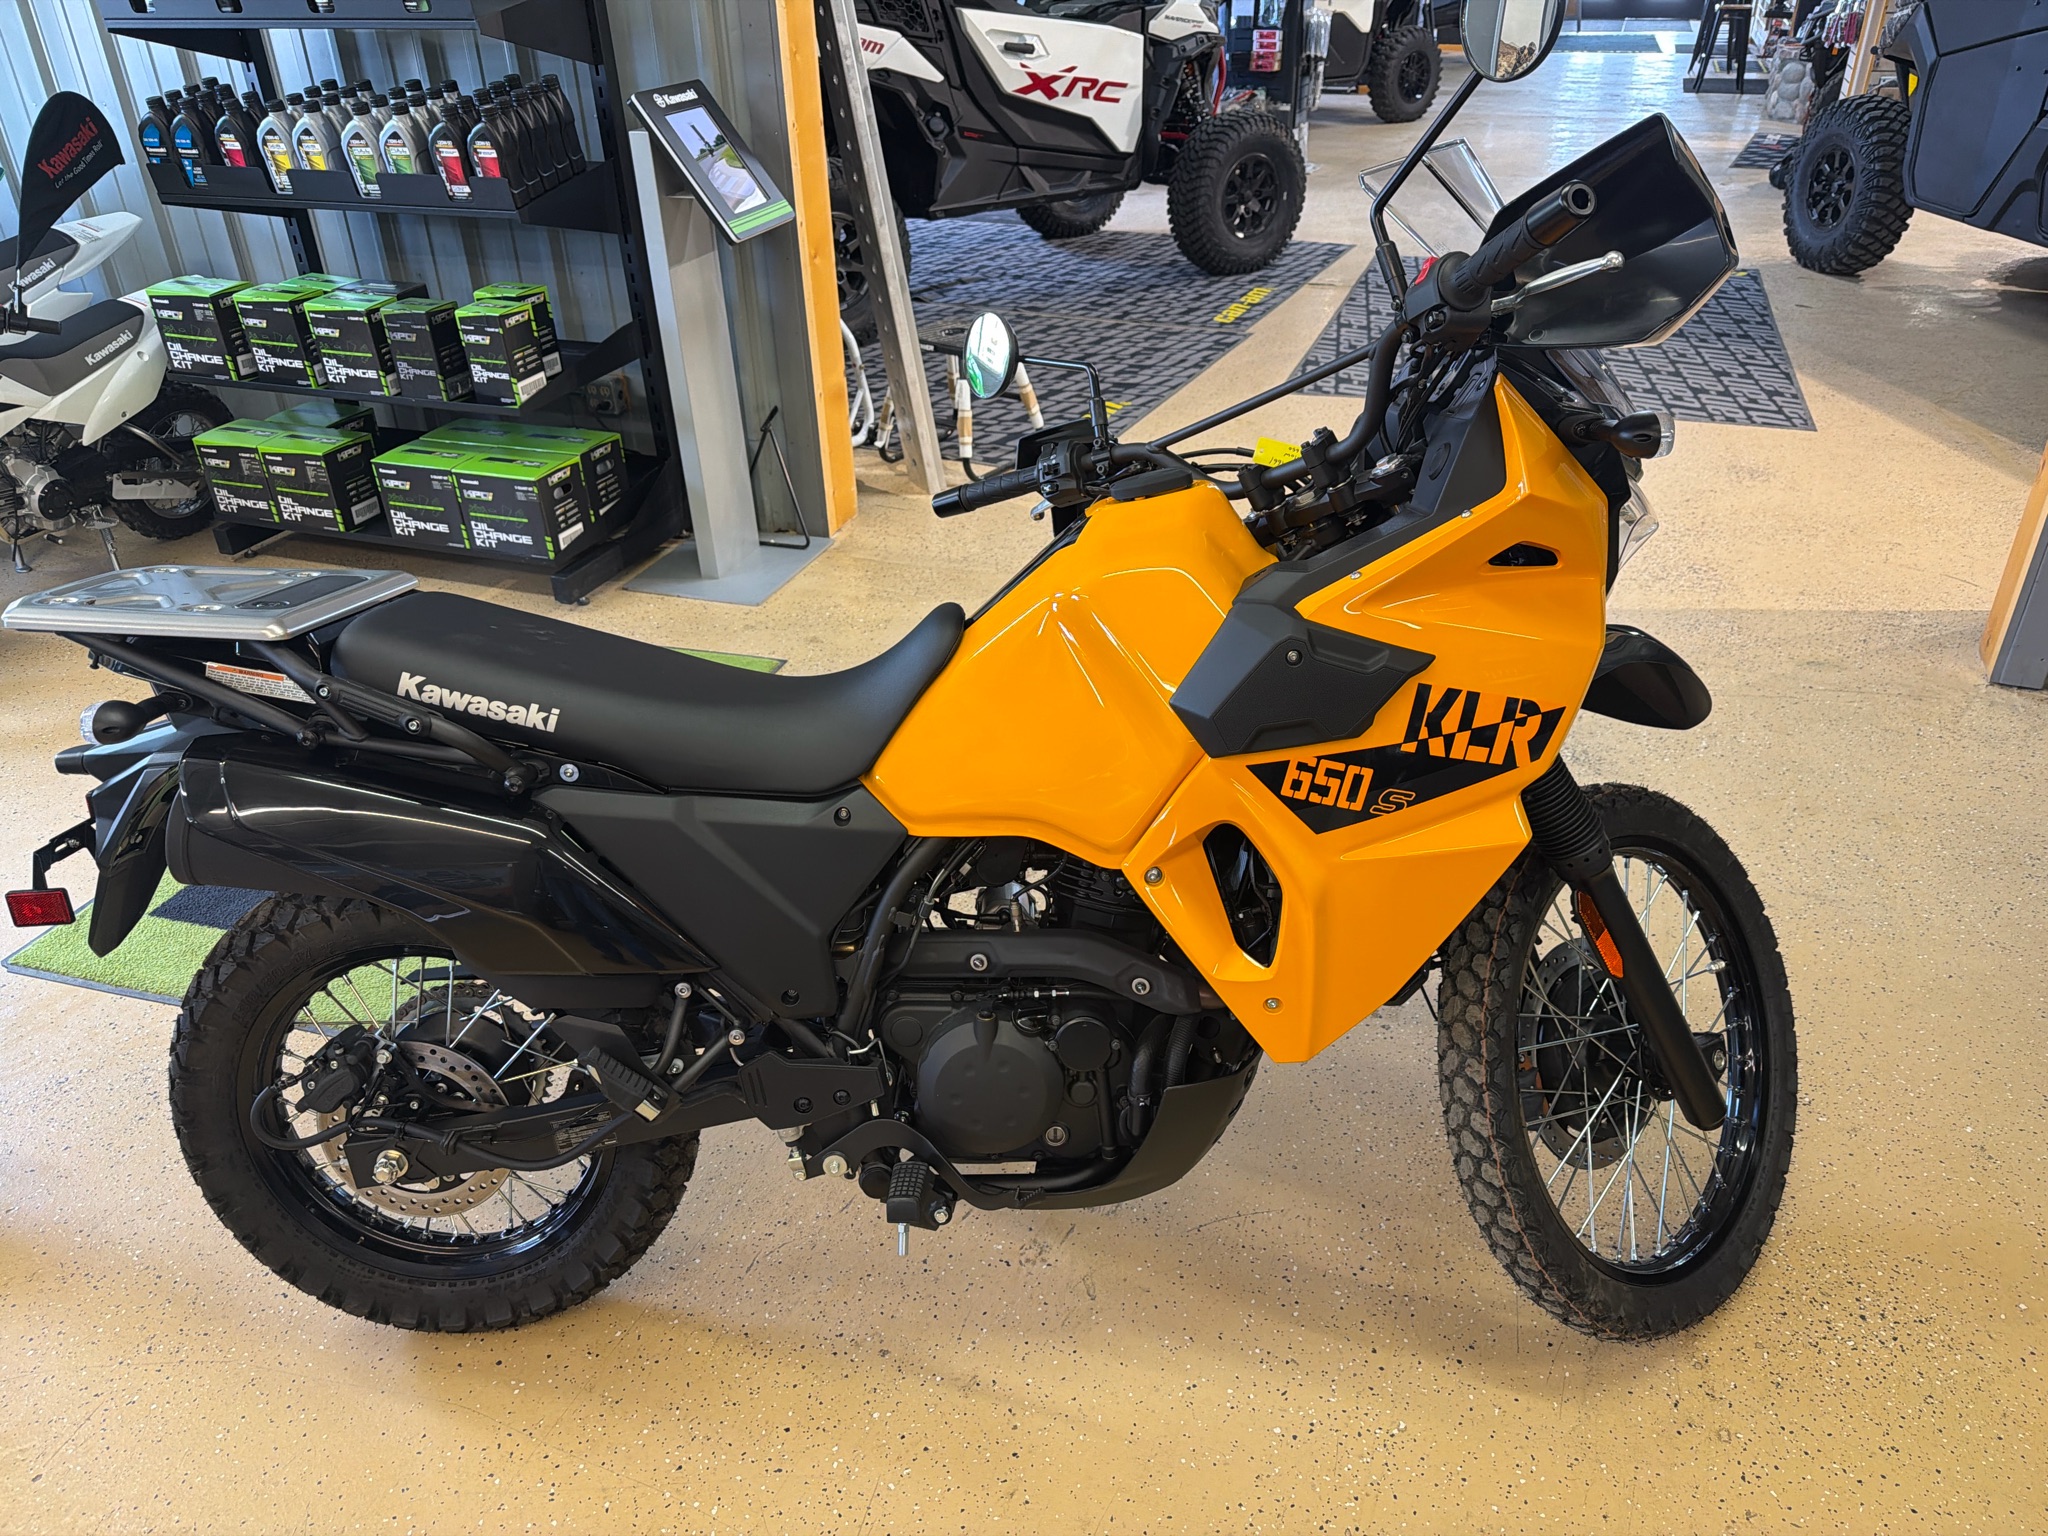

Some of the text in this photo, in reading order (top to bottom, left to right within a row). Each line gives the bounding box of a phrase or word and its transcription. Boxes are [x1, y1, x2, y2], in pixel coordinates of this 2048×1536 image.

[1012, 62, 1128, 103] XRC
[663, 88, 698, 105] Kawasaki
[37, 116, 98, 178] Kawasaki
[54, 139, 104, 188] Let the Good Times Roll
[1213, 287, 1273, 324] can-am
[84, 329, 134, 366] Kawasaki
[167, 342, 188, 352] OIL
[252, 347, 272, 357] OIL
[170, 351, 224, 365] CHANGE
[256, 356, 304, 368] CHANGE
[322, 358, 344, 368] OIL
[172, 360, 192, 370] KIT
[258, 365, 276, 374] KIT
[470, 364, 486, 372] OIL
[325, 366, 378, 379] CHANGE
[399, 368, 436, 377] CHANGE
[472, 370, 510, 380] CHANGE
[328, 375, 347, 384] KIT
[214, 487, 234, 498] OIL
[216, 495, 270, 510] CHANGE
[278, 495, 299, 506] OIL
[218, 504, 239, 514] KIT
[280, 504, 334, 518] CHANGE
[282, 512, 302, 522] KIT
[390, 510, 413, 520] OIL
[392, 518, 450, 533] CHANGE
[396, 526, 416, 536] KIT
[470, 521, 495, 532] OIL
[473, 529, 534, 545] CHANGE
[476, 538, 498, 548] KIT
[396, 671, 561, 733] Kawasaki
[1400, 682, 1543, 767] KLR
[1280, 756, 1416, 816] 650 S
